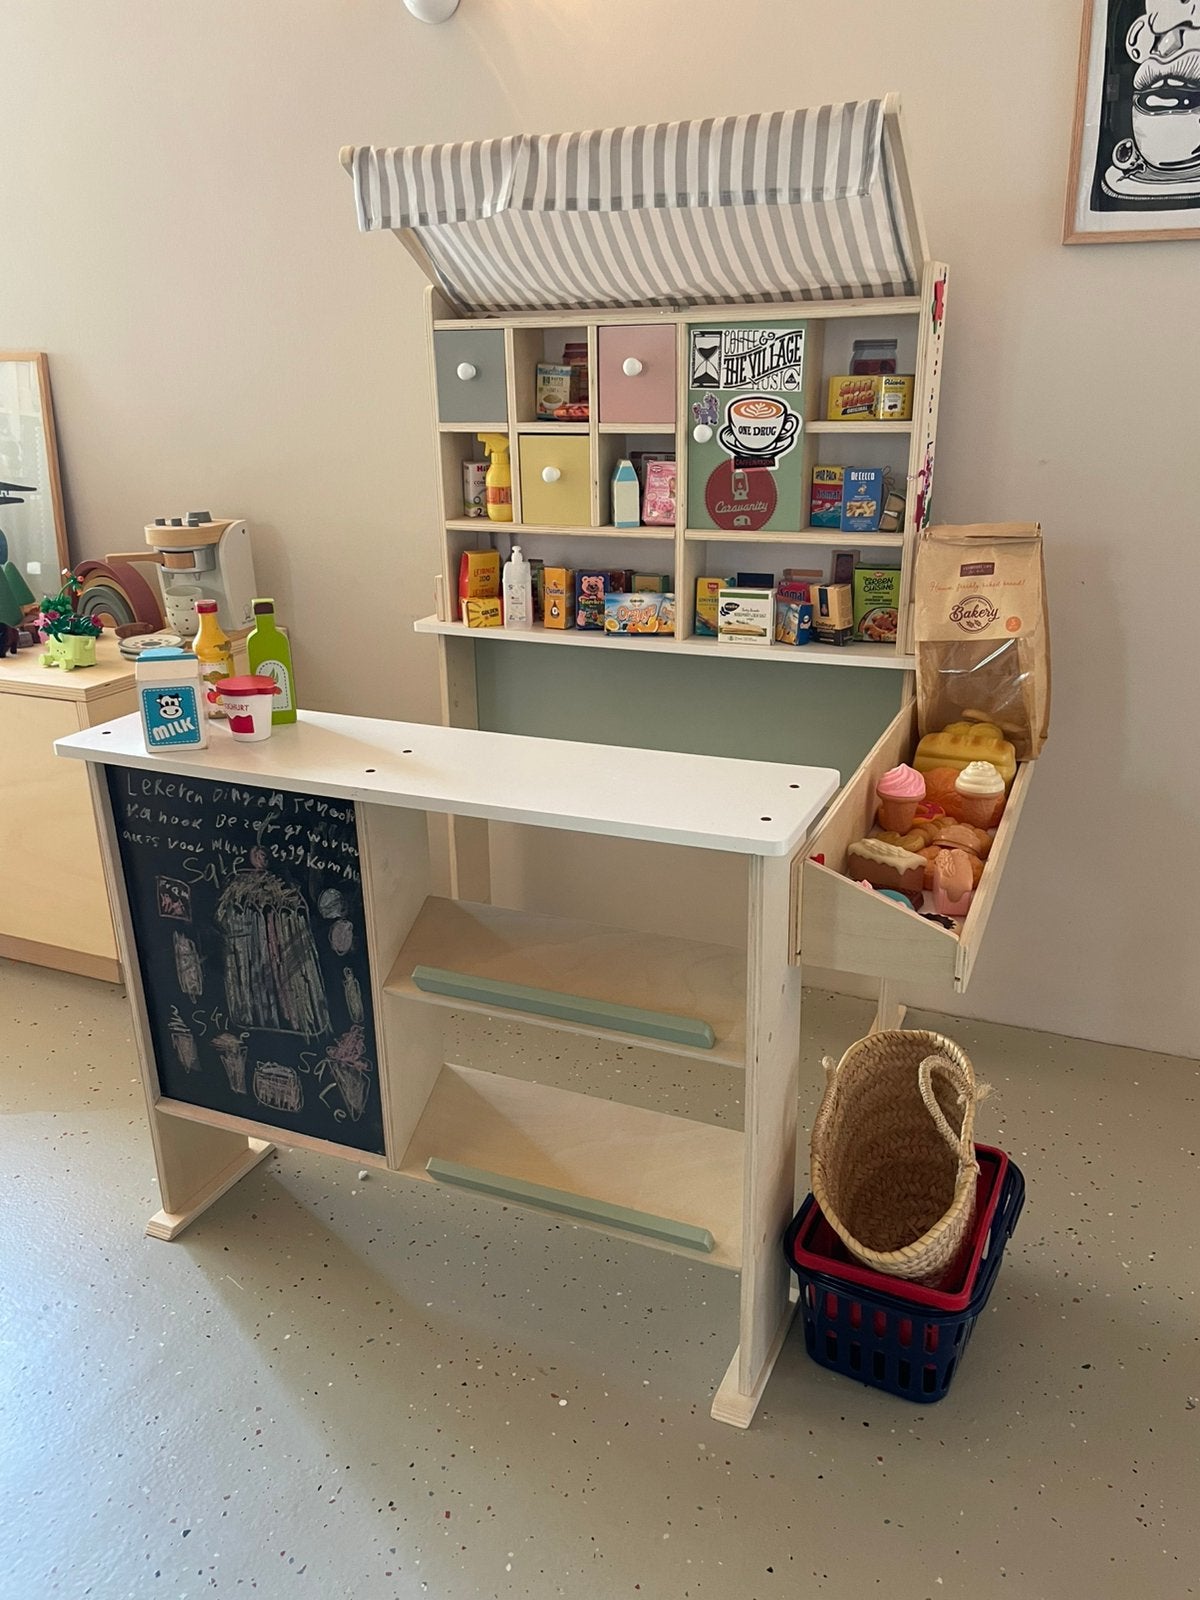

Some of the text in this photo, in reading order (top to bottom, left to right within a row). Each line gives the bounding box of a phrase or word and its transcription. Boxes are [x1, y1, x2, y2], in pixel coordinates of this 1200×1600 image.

[723, 334, 802, 386] THE VILLAGE
[738, 425, 777, 436] ONE DRUG
[715, 500, 768, 513] Caravanity
[949, 604, 1000, 623] Bakery
